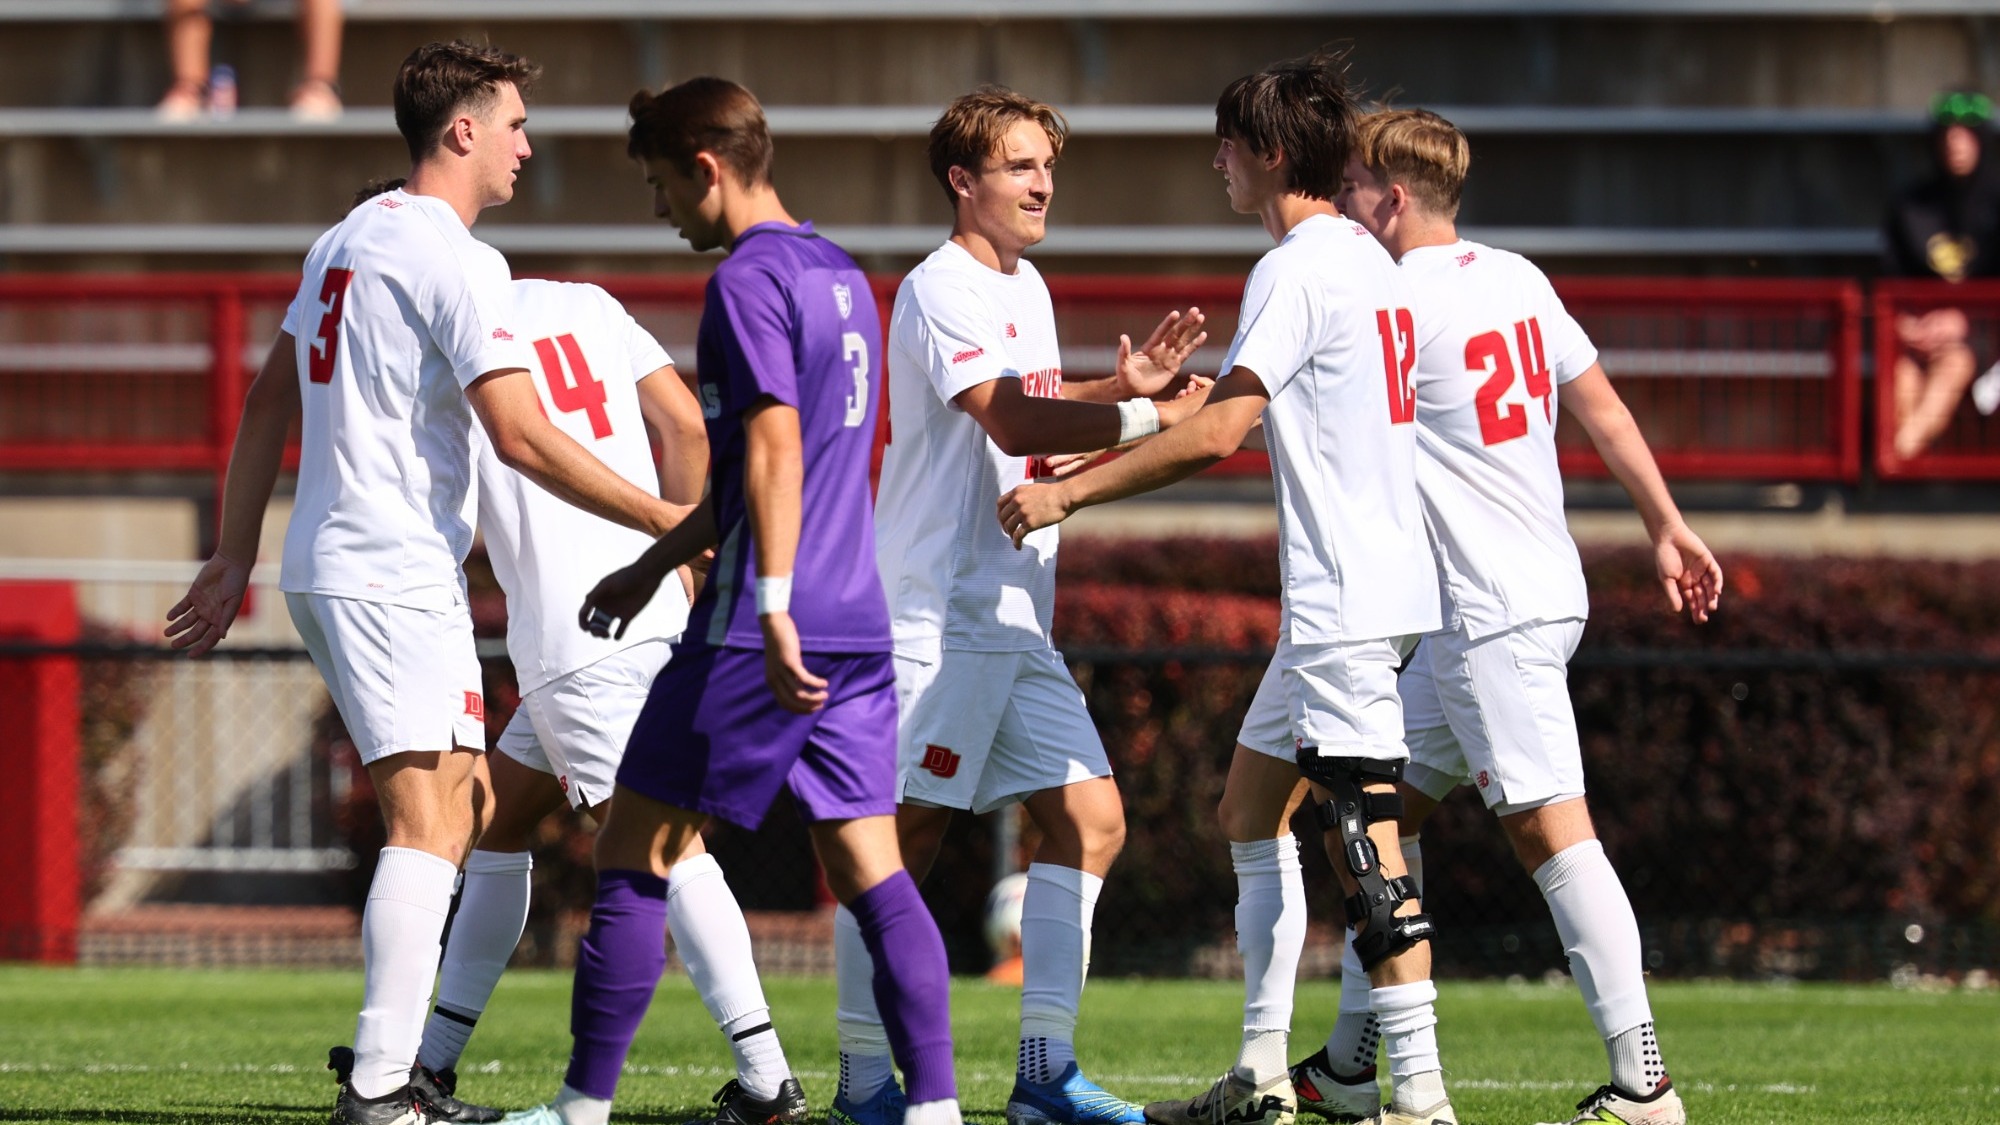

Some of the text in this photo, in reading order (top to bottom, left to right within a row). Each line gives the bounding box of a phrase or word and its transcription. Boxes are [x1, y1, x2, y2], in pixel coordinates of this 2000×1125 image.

[309, 267, 354, 384] 3
[842, 332, 868, 426] 3
[1376, 307, 1416, 425] 12
[1464, 315, 1552, 446] 24
[531, 331, 614, 440] 4
